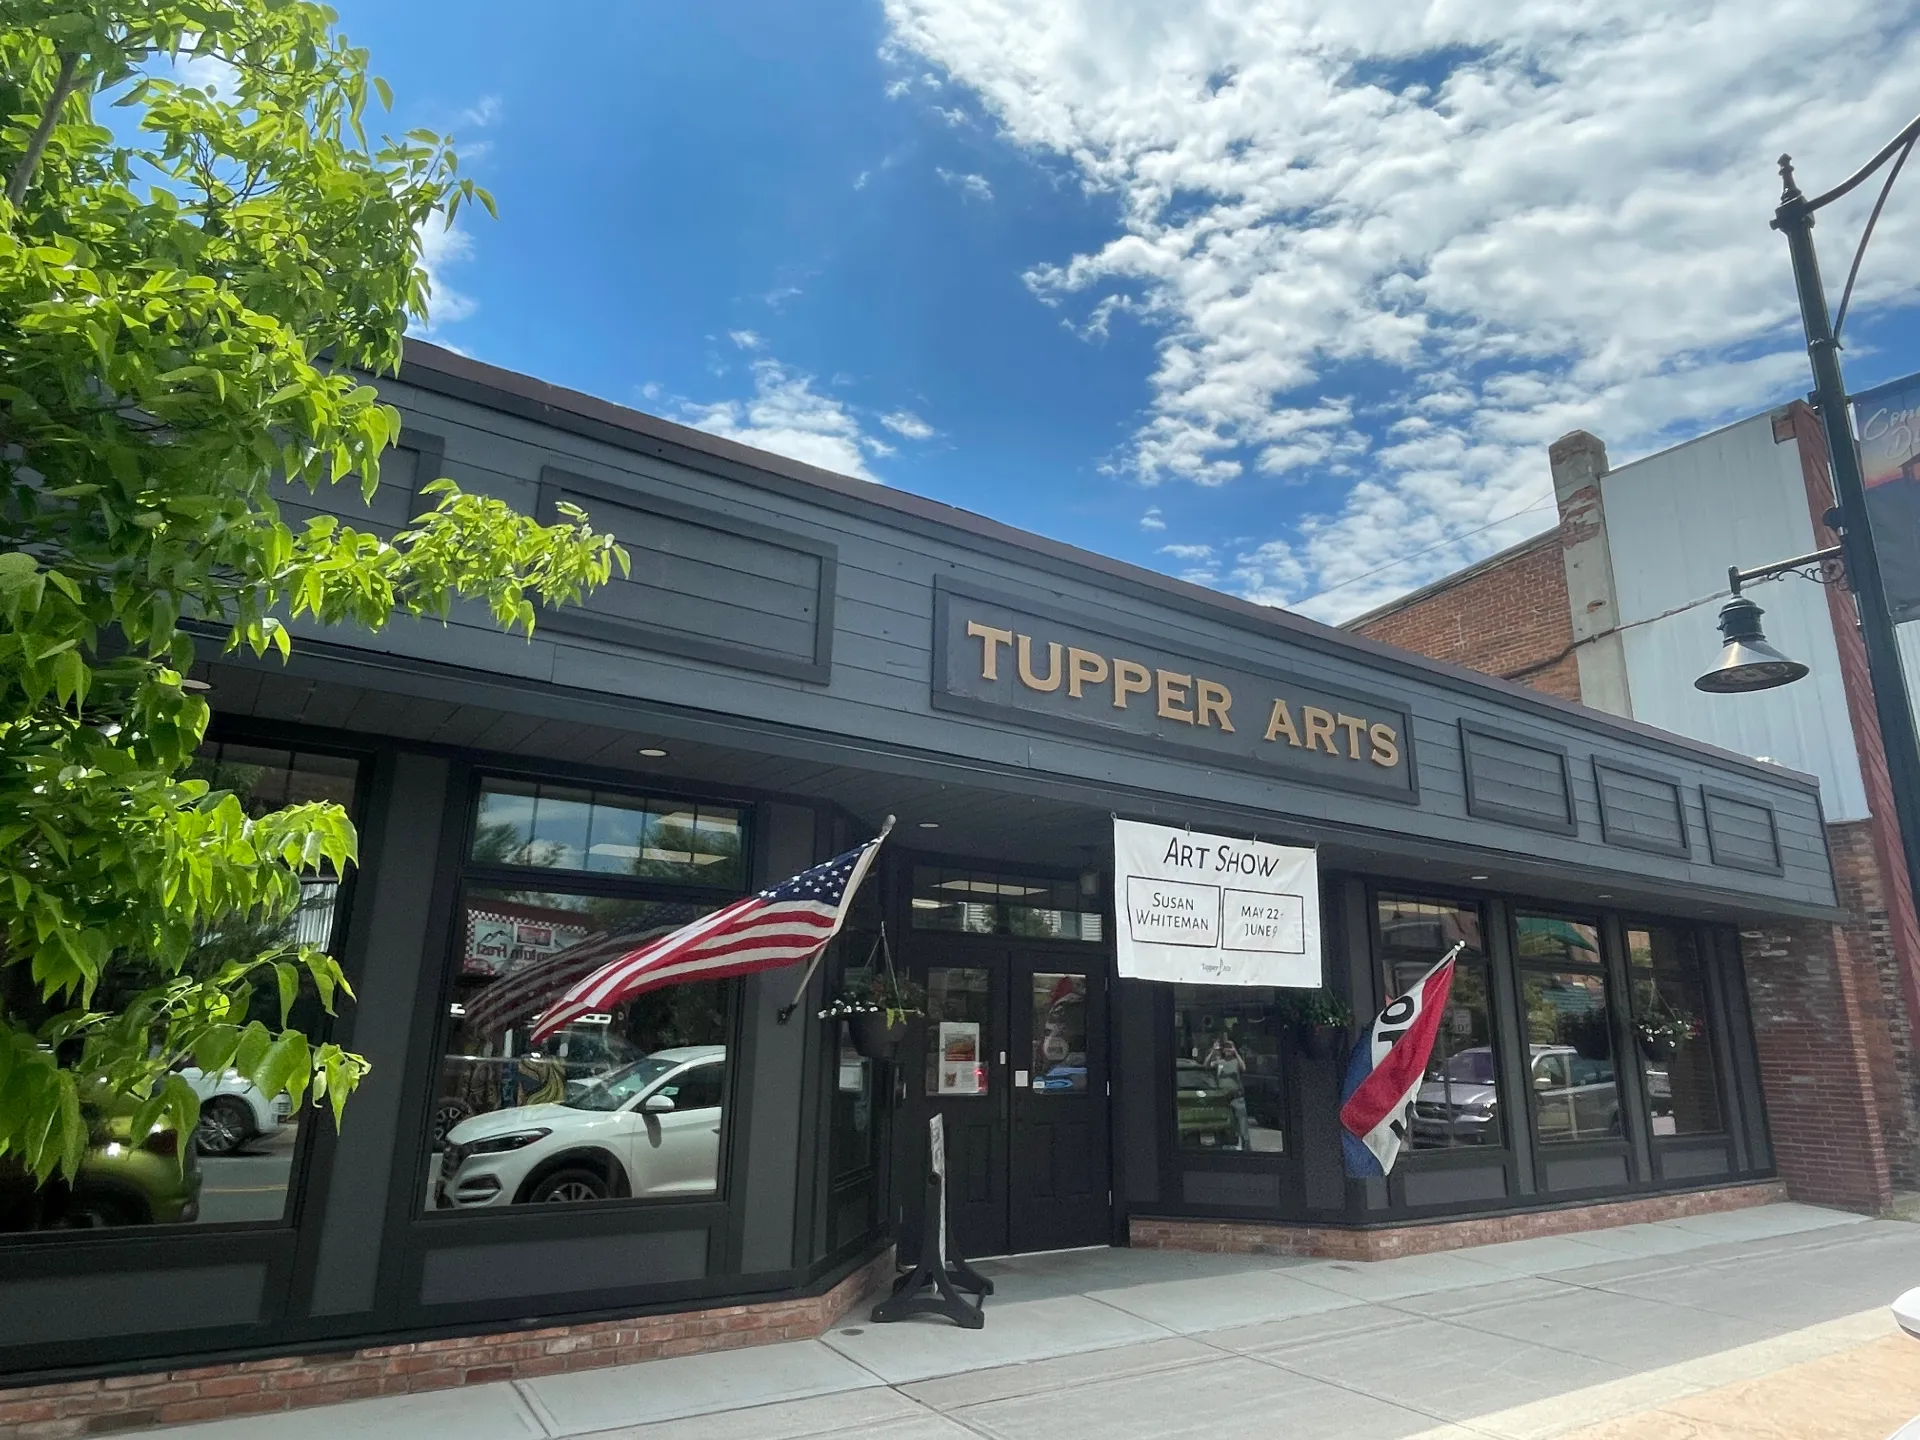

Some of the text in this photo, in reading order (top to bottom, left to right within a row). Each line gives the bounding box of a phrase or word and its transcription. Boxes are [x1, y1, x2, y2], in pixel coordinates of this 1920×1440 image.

[966, 620, 1399, 767] TUPPER ARTS
[1163, 836, 1280, 877] ART SHOW
[1152, 892, 1194, 911] SUSAN
[1241, 905, 1264, 919] MAY
[1135, 908, 1209, 931] WHITEMAN
[1245, 923, 1271, 937] JUNE
